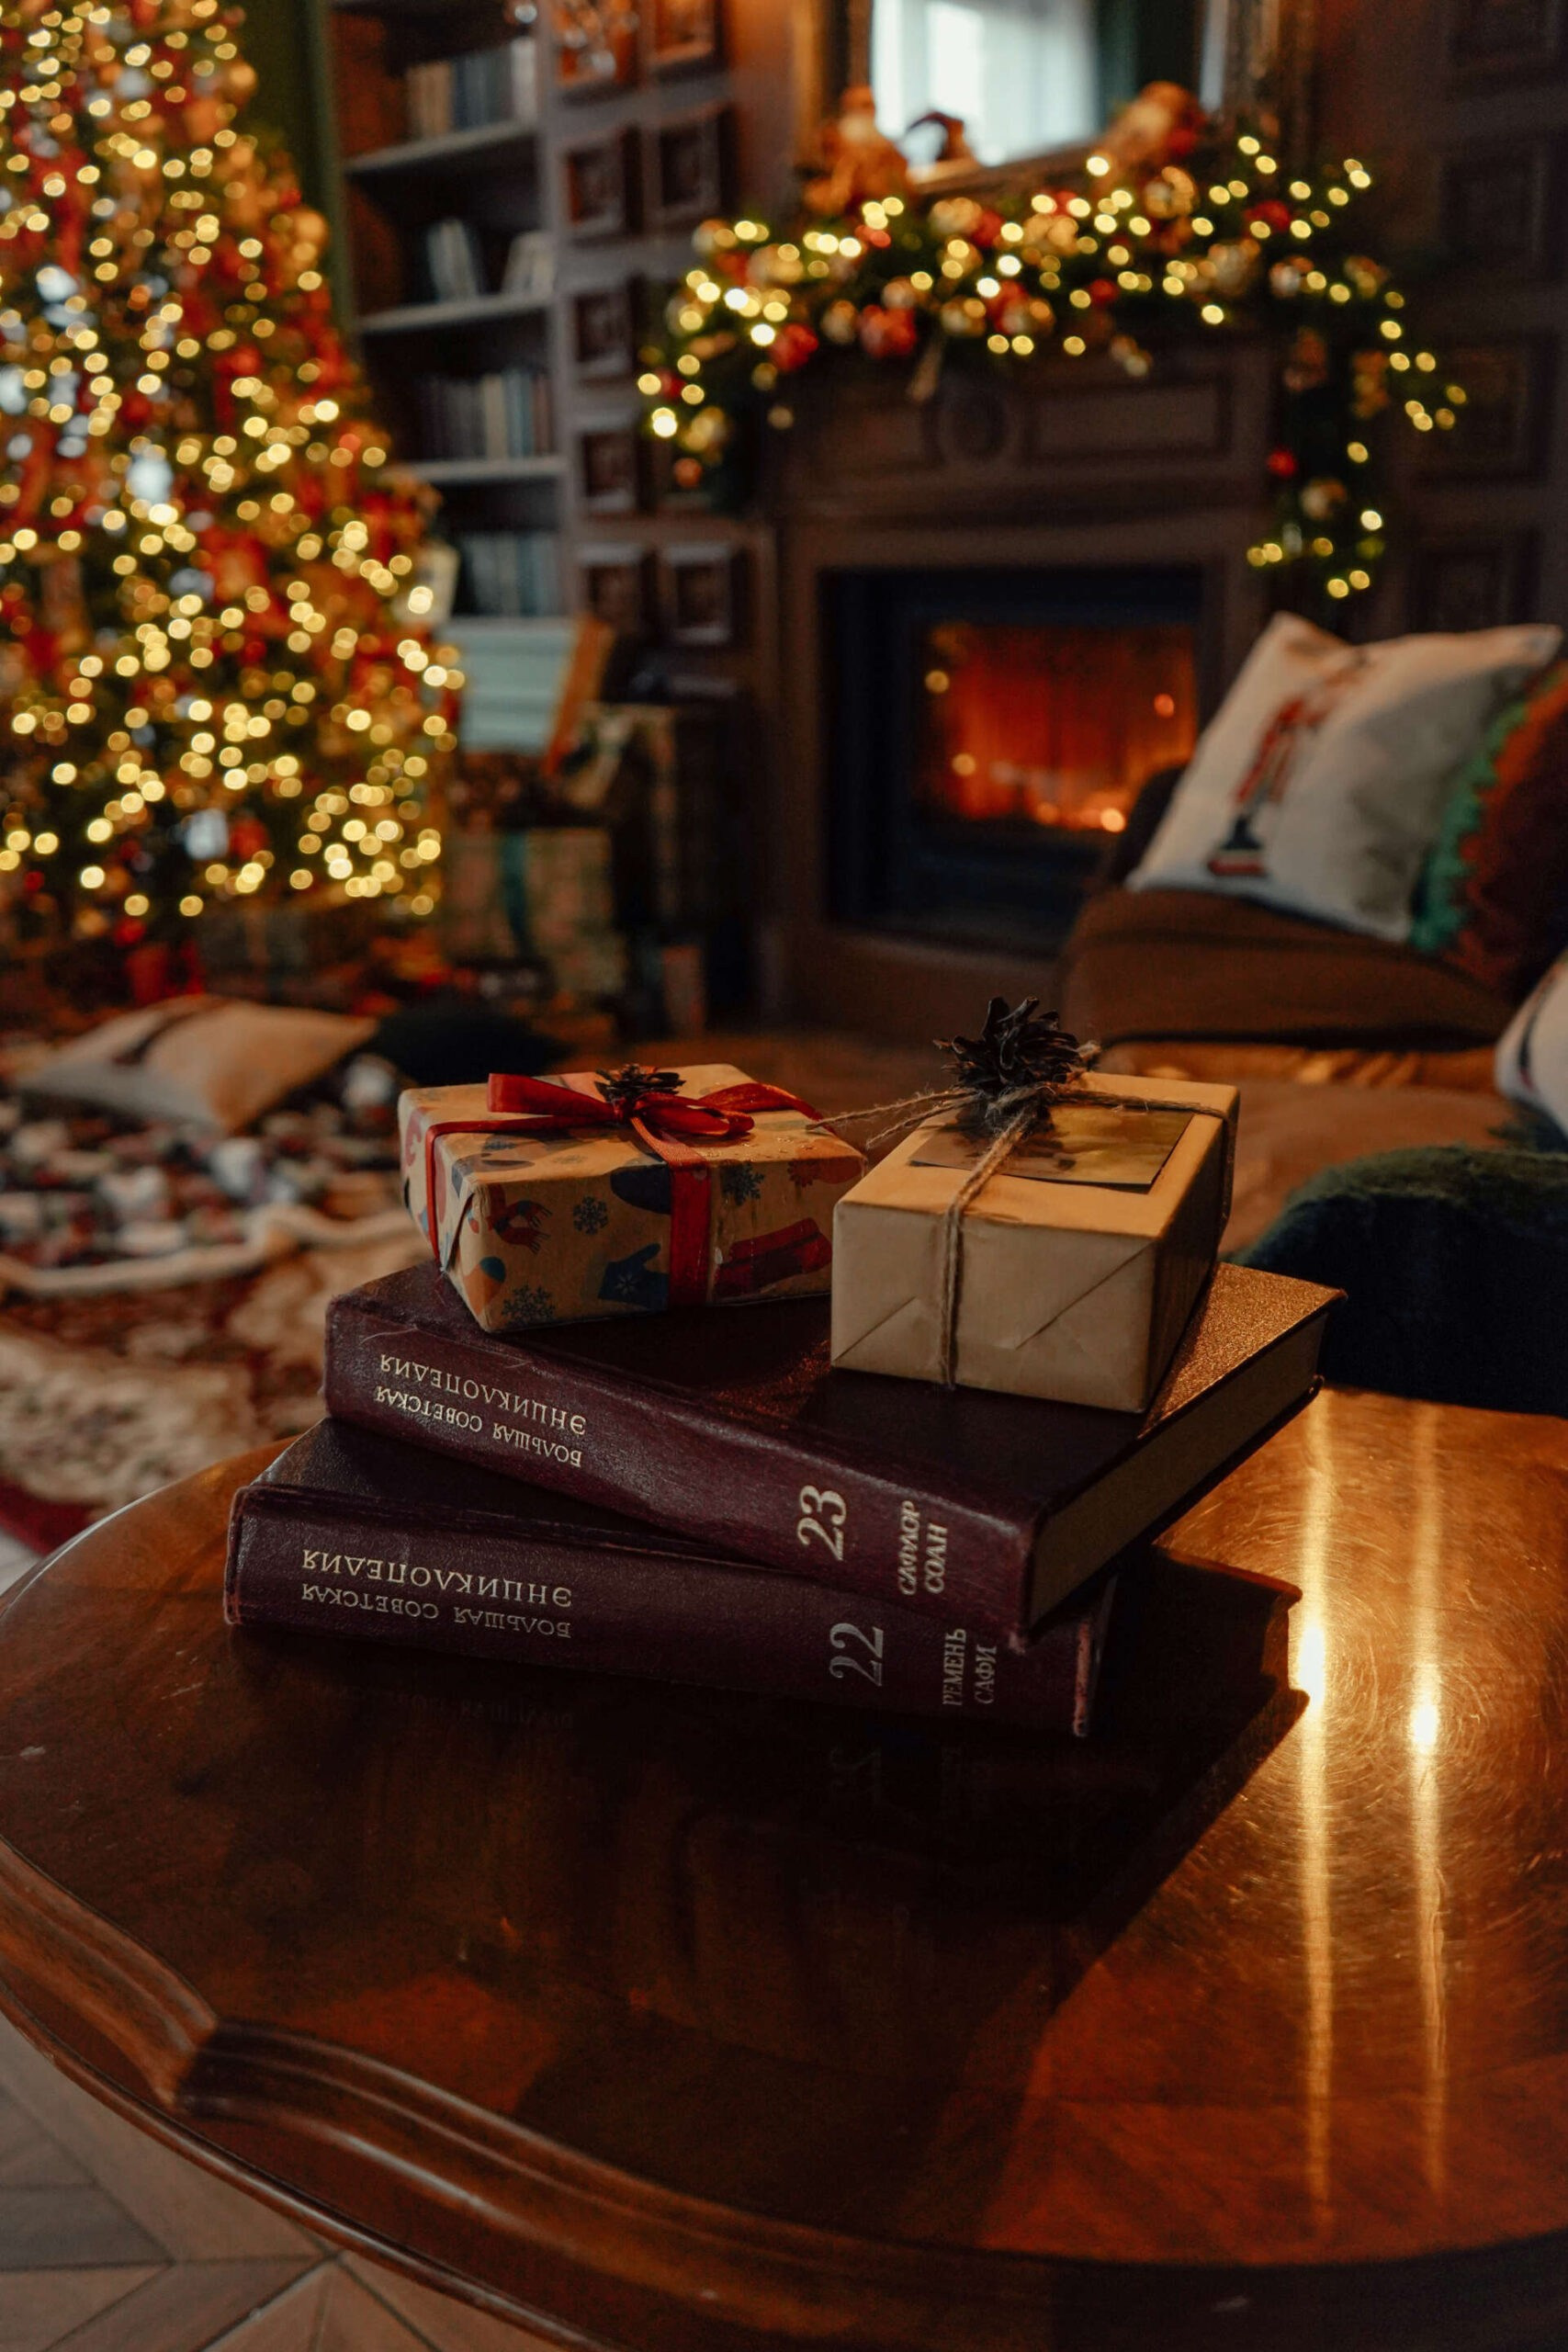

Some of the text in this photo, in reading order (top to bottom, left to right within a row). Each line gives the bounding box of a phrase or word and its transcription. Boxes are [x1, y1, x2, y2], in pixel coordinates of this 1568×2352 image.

[374, 1386, 582, 1467] БОЛЬШАЯ СОВЕТСКАЯ
[380, 1354, 586, 1435] ЭНЦИКЛОПЕДИЯ
[796, 1485, 847, 1561] 23
[897, 1500, 920, 1595] САФЛОР
[924, 1522, 948, 1594] СОАН
[301, 1583, 571, 1638] БОЛЬШАЯ СОВЕТСКАЯ
[302, 1549, 572, 1607] ЭНЦИКЛОПЕДИЯ
[829, 1623, 884, 1687] 22
[942, 1628, 966, 1706] РЕМЕНЬ
[974, 1644, 997, 1704] САФИ
